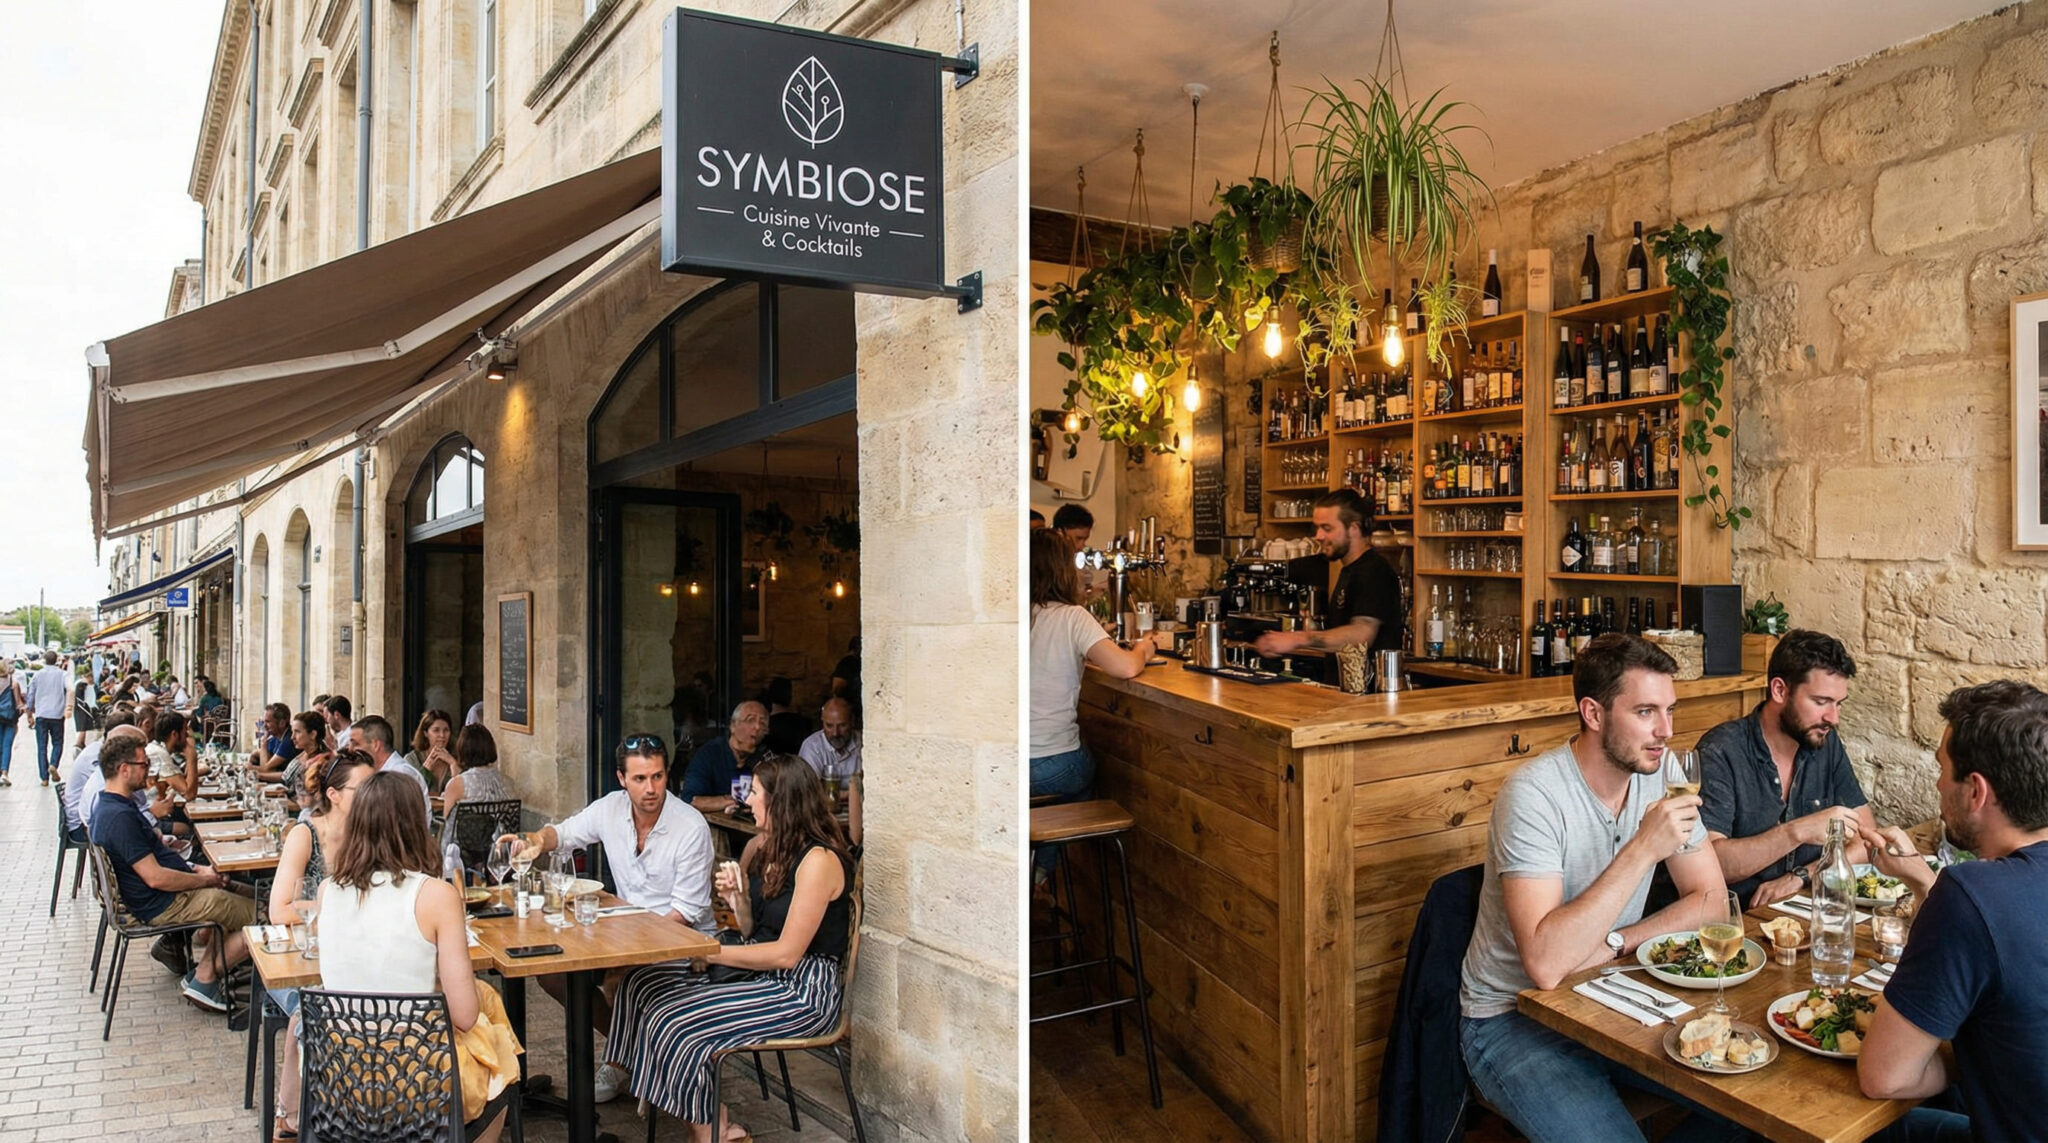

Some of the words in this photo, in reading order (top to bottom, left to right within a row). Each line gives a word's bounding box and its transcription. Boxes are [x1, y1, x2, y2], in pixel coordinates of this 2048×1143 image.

[696, 146, 925, 214] SYMBIOSE
[743, 204, 810, 229] Cuisine
[815, 213, 880, 238] Vivante
[761, 229, 777, 248] &
[782, 232, 863, 258] Cocktails
